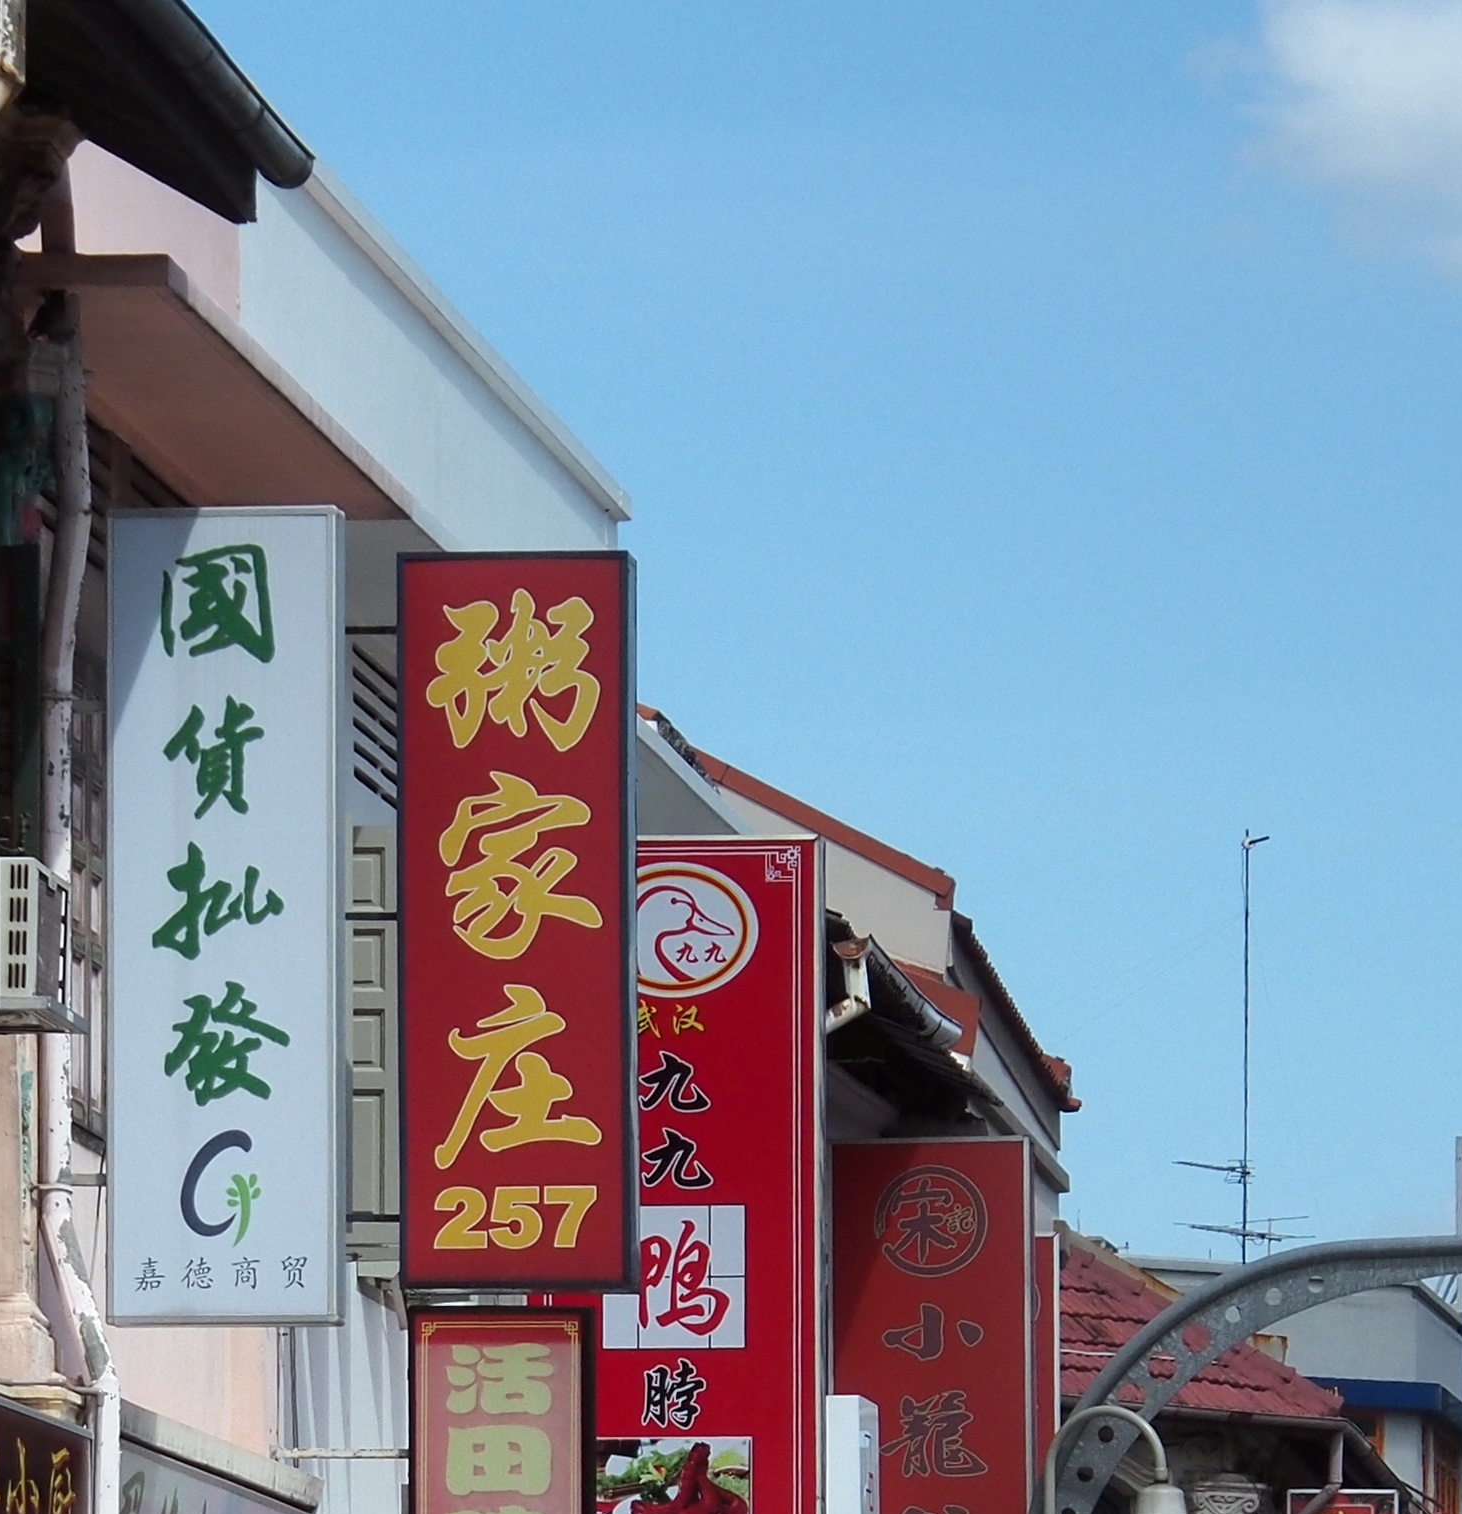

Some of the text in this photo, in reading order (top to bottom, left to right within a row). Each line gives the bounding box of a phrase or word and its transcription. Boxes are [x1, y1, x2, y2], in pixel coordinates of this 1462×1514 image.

[426, 587, 604, 1171] 粥家庄
[674, 941, 727, 965] 九九
[433, 1184, 600, 1250] 257
[135, 1256, 309, 1292] 嘉德商贸
